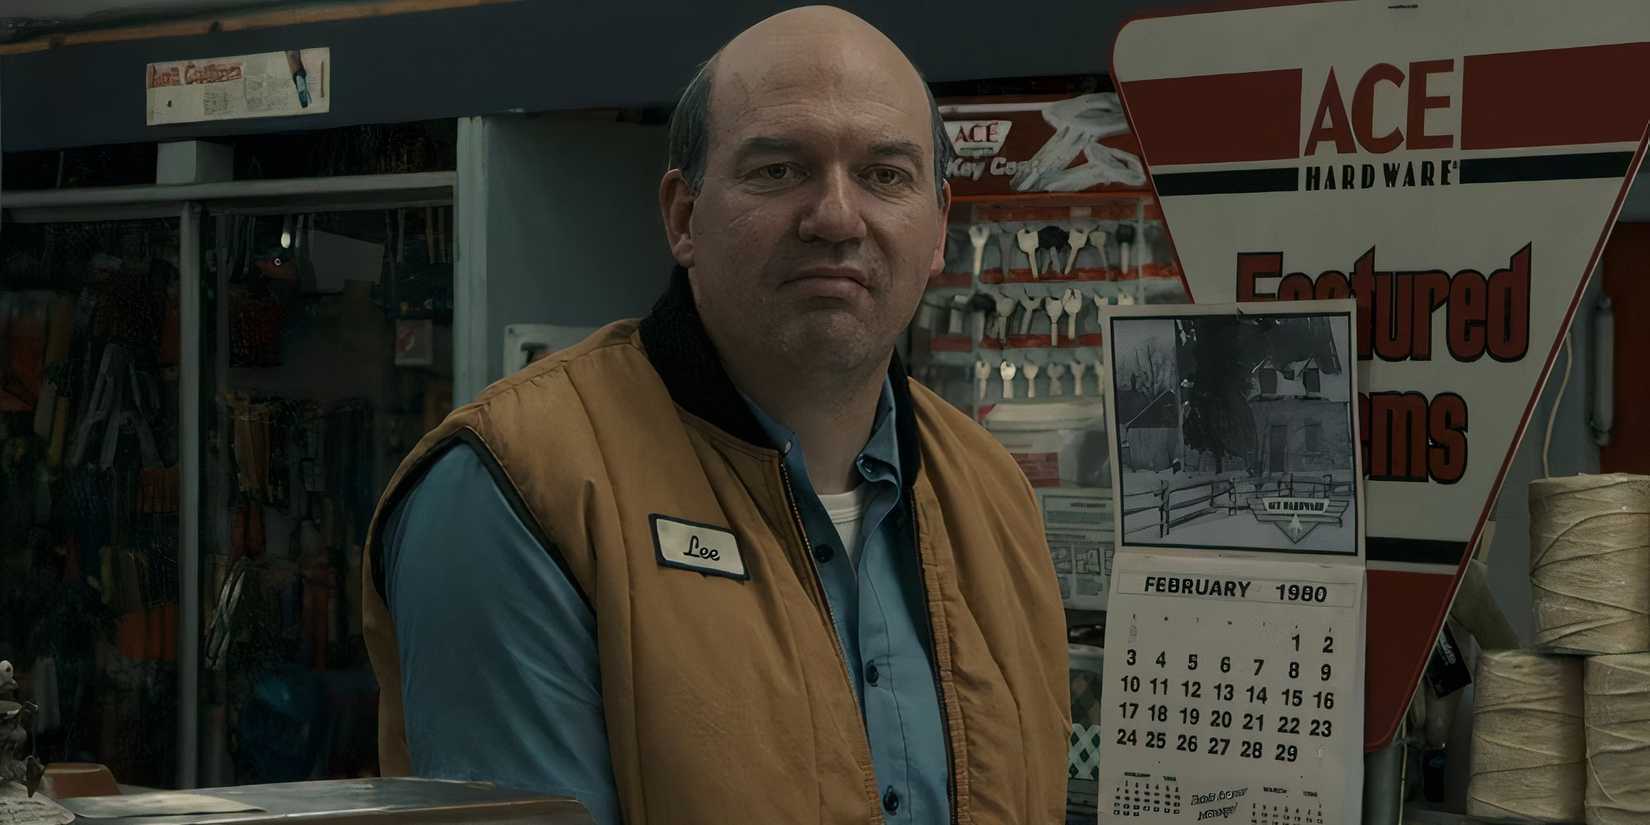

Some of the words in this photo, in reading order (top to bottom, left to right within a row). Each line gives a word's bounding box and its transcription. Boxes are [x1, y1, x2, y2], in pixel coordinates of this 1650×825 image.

[1304, 59, 1454, 156] ACE
[954, 121, 999, 143] ACE
[1306, 160, 1452, 191] HARDWARE
[683, 535, 720, 561] Lee
[1144, 576, 1251, 598] FEBRUARY
[1276, 584, 1327, 603] 1980
[1291, 633, 1301, 652] 1
[1321, 635, 1334, 654] 2
[1126, 648, 1137, 667] 3
[1155, 650, 1167, 669] 4
[1187, 653, 1199, 671] 5
[1219, 655, 1231, 674] 6
[1253, 658, 1265, 677] 7
[1288, 661, 1300, 680] 8
[1320, 663, 1332, 682] 9
[1120, 674, 1141, 693] 10
[1149, 677, 1169, 696] 11
[1180, 679, 1202, 699] 12
[1213, 682, 1235, 702] 13
[1245, 685, 1269, 705] 14
[1281, 687, 1304, 708] 15
[1312, 690, 1335, 710] 16
[1118, 701, 1140, 720] 17
[1147, 703, 1169, 723] 18
[1178, 706, 1200, 726] 19
[1209, 709, 1233, 729] 20
[1241, 712, 1265, 732] 21
[1276, 715, 1301, 735] 22
[1308, 718, 1333, 738] 23
[1115, 728, 1138, 747] 24
[1144, 730, 1167, 750] 25
[1175, 733, 1199, 753] 26
[1207, 736, 1231, 756] 27
[1239, 740, 1263, 760] 28
[1274, 743, 1298, 763] 29
